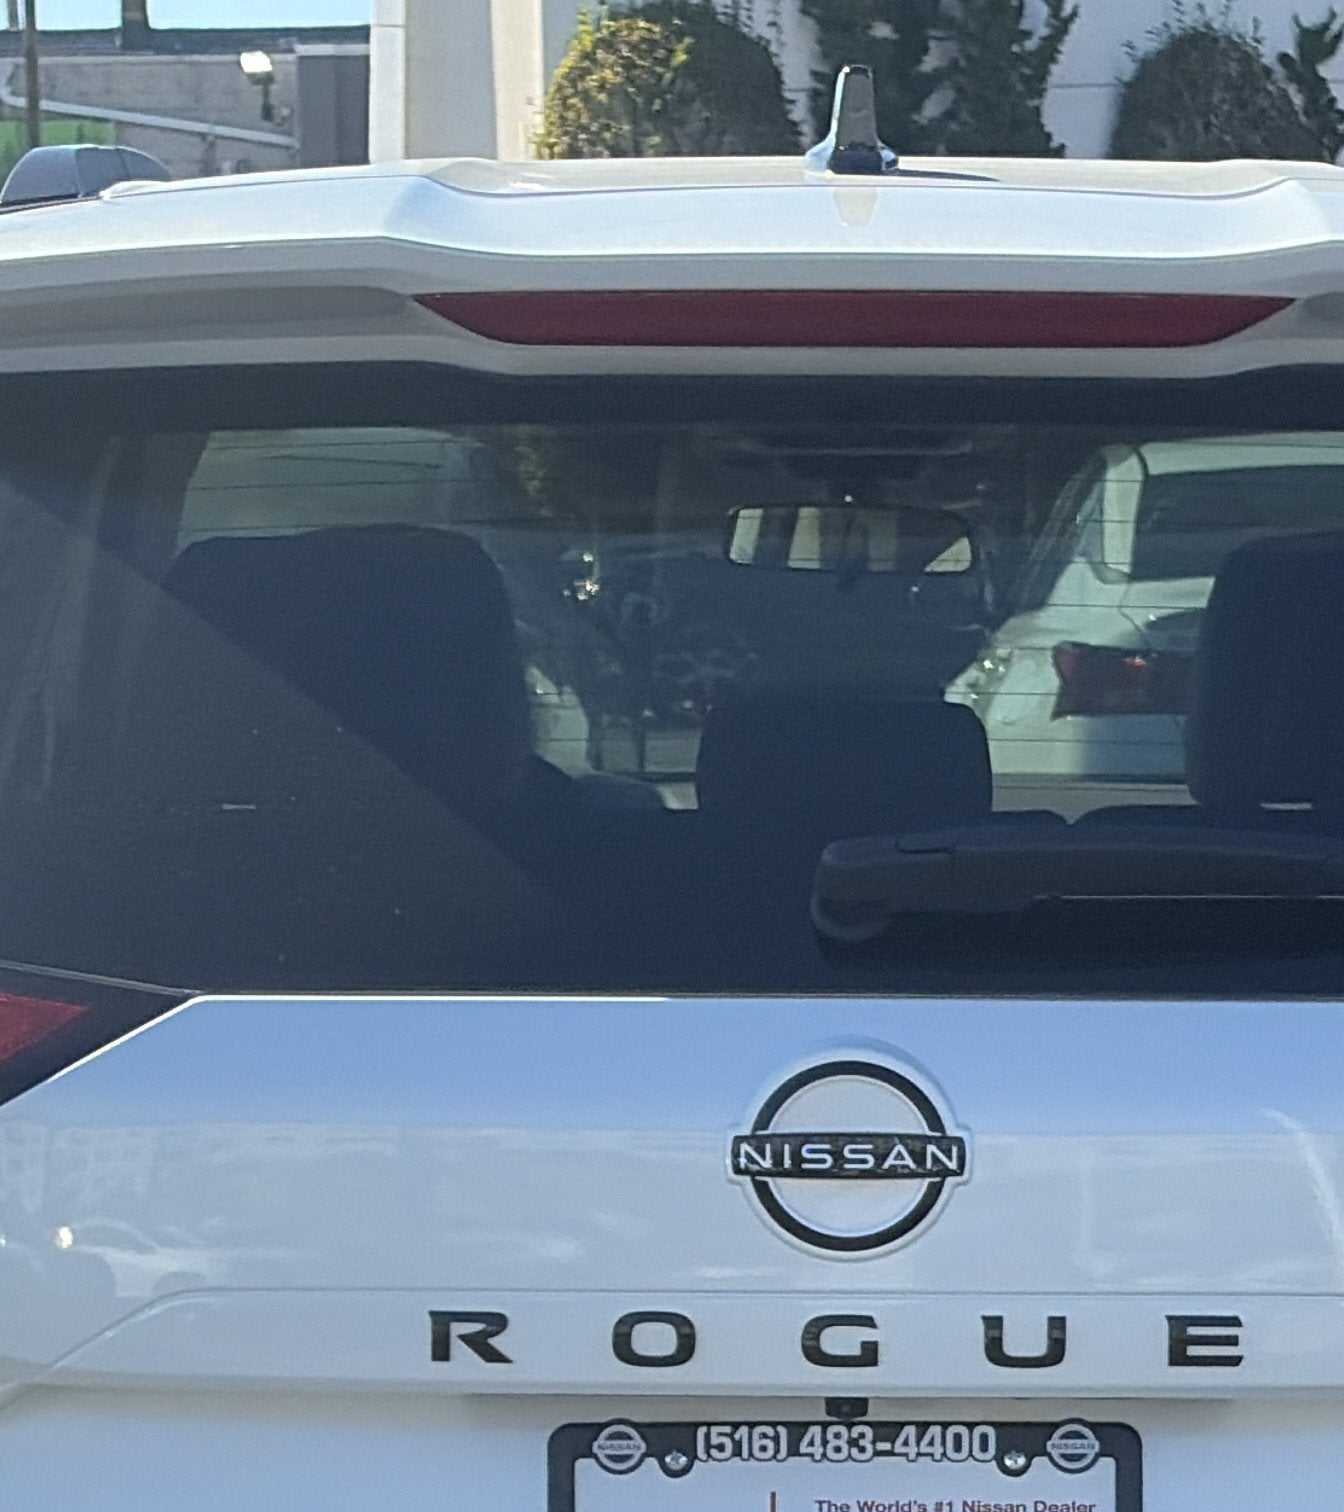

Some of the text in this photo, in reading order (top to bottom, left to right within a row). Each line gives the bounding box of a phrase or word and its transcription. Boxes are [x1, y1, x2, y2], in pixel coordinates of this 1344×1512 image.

[739, 1141, 958, 1170] NISSAN
[427, 1310, 1246, 1368] ROGUE
[696, 1424, 996, 1462] (516) 483-4400
